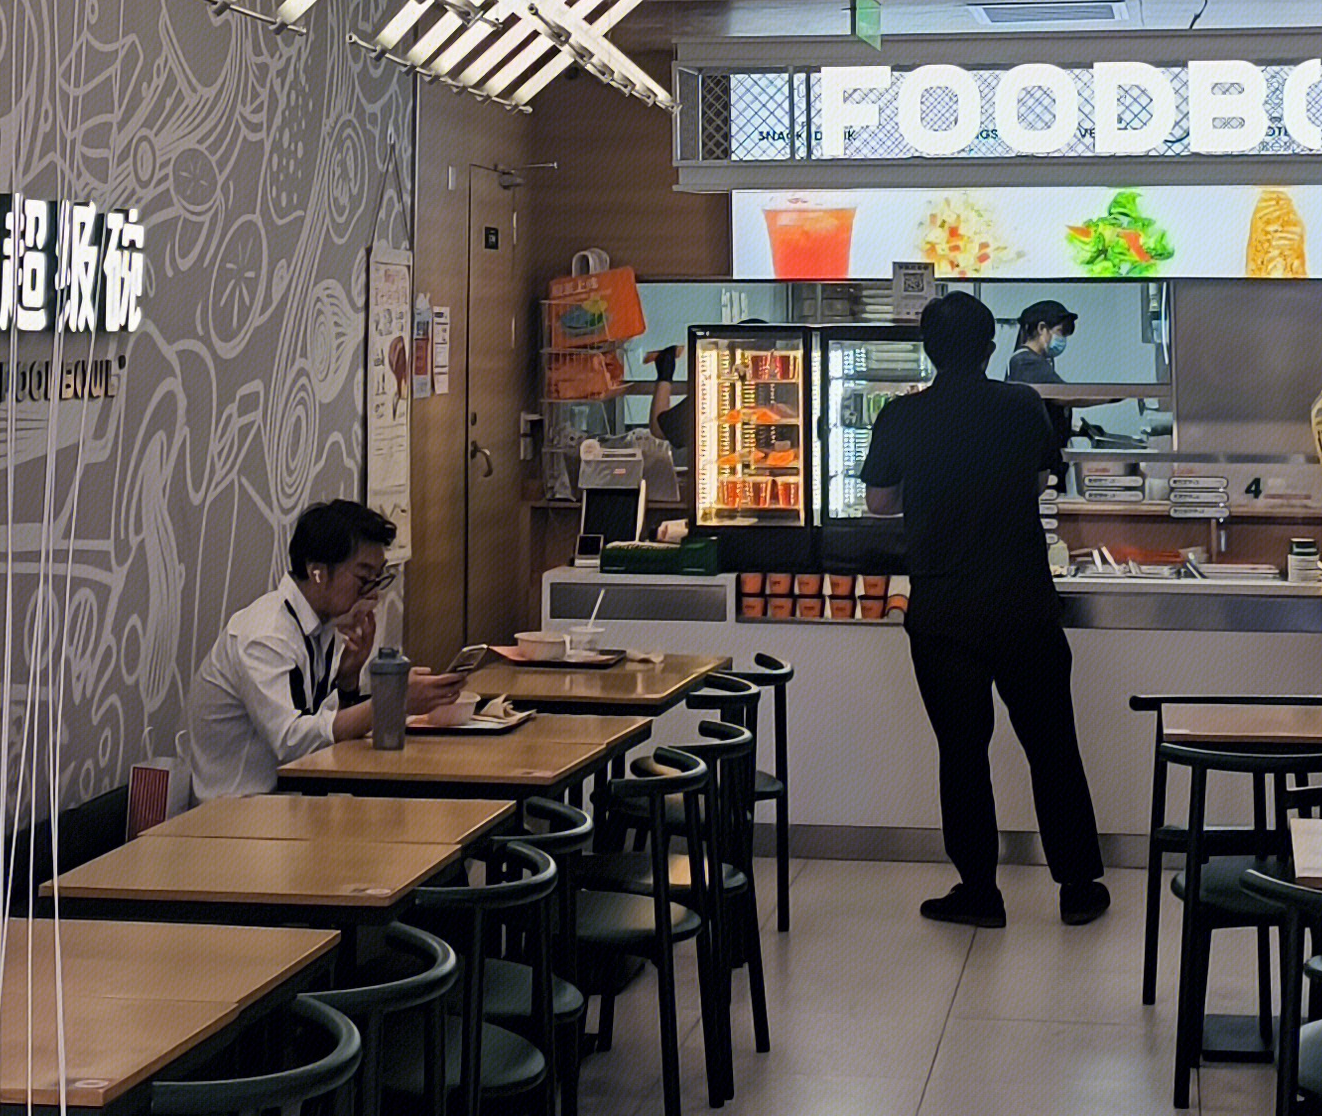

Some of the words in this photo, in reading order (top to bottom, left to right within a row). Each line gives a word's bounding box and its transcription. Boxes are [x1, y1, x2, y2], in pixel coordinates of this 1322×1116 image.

[0, 192, 145, 333] 超级碗
[1245, 477, 1263, 500] 4
